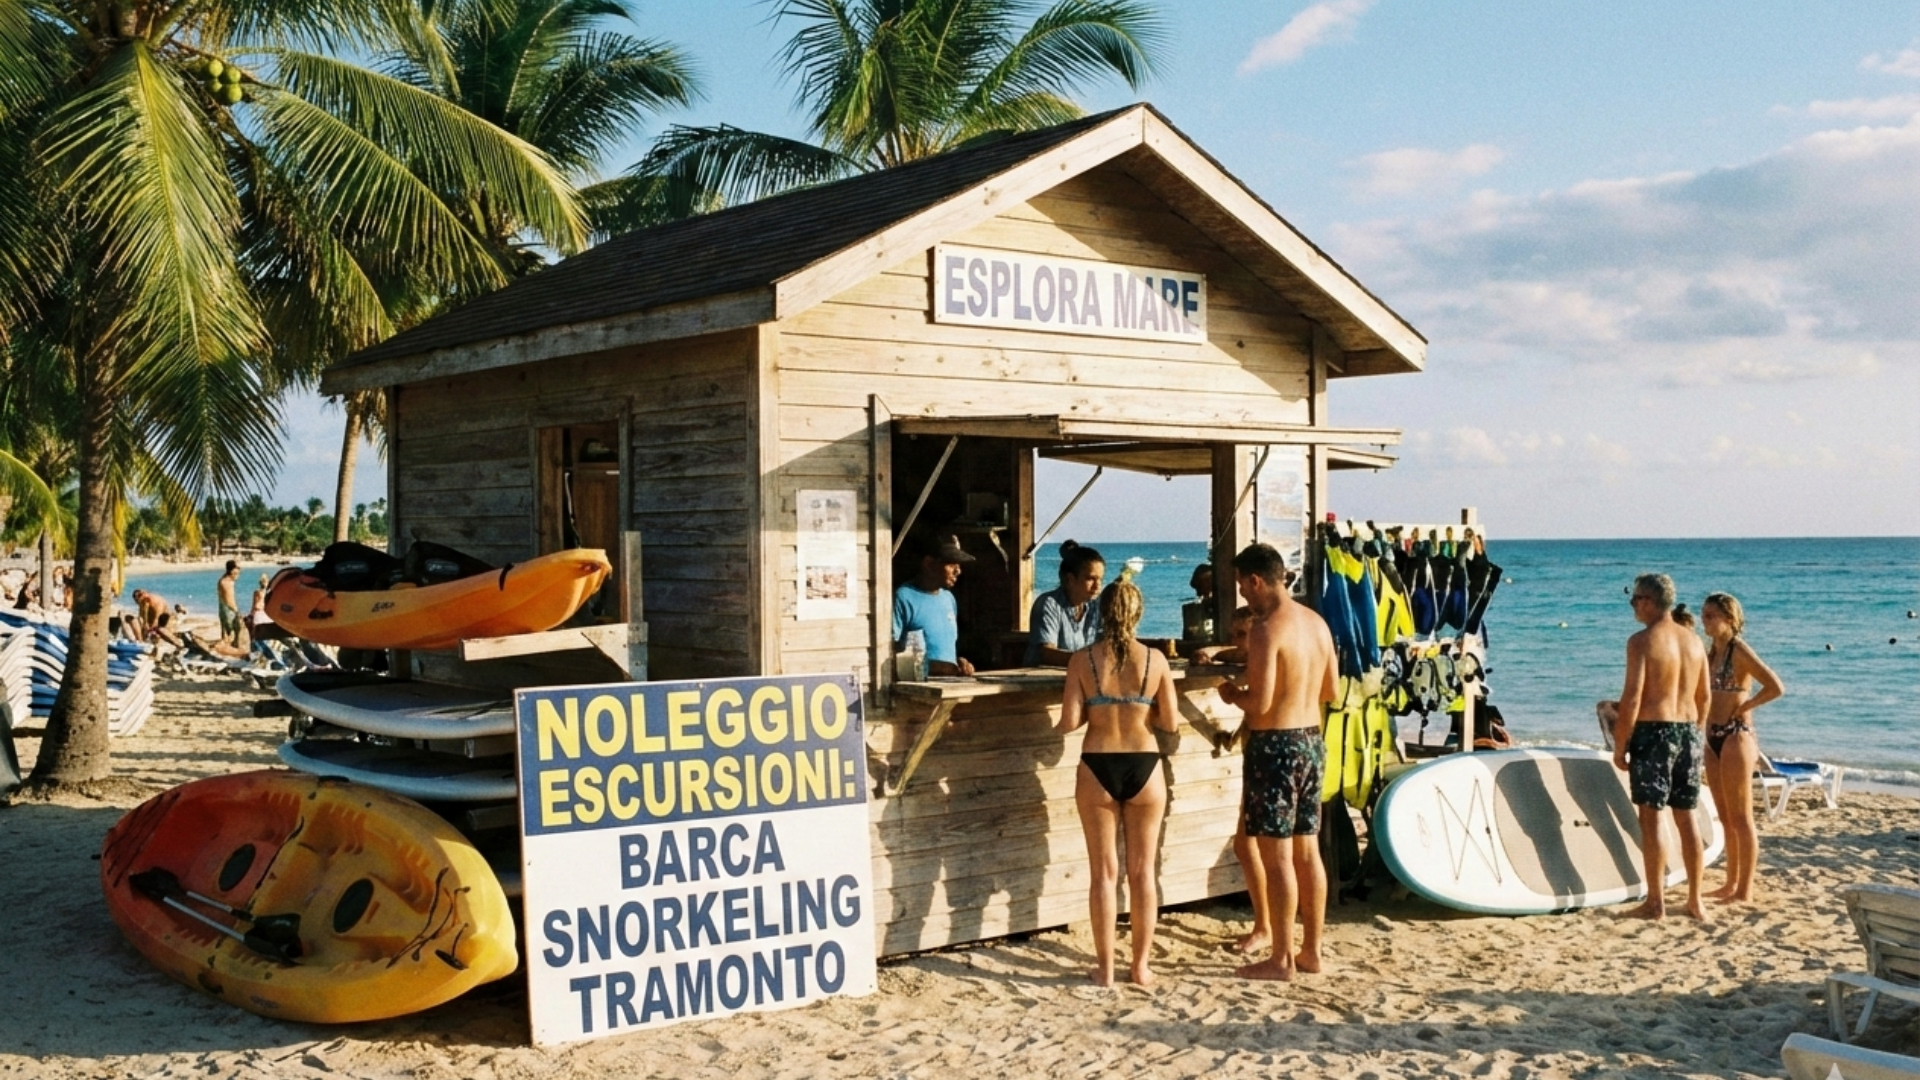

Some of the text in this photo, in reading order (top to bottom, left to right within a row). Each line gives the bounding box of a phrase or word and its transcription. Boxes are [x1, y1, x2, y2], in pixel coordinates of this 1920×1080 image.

[945, 255, 1200, 335] ESPLORA MARE
[536, 682, 848, 761] NOLEGGIO
[539, 748, 856, 827] ESCURSIONI:
[619, 820, 785, 890] BARCA
[542, 874, 861, 968] SNORKELING
[569, 940, 846, 1034] TRAMONTO
